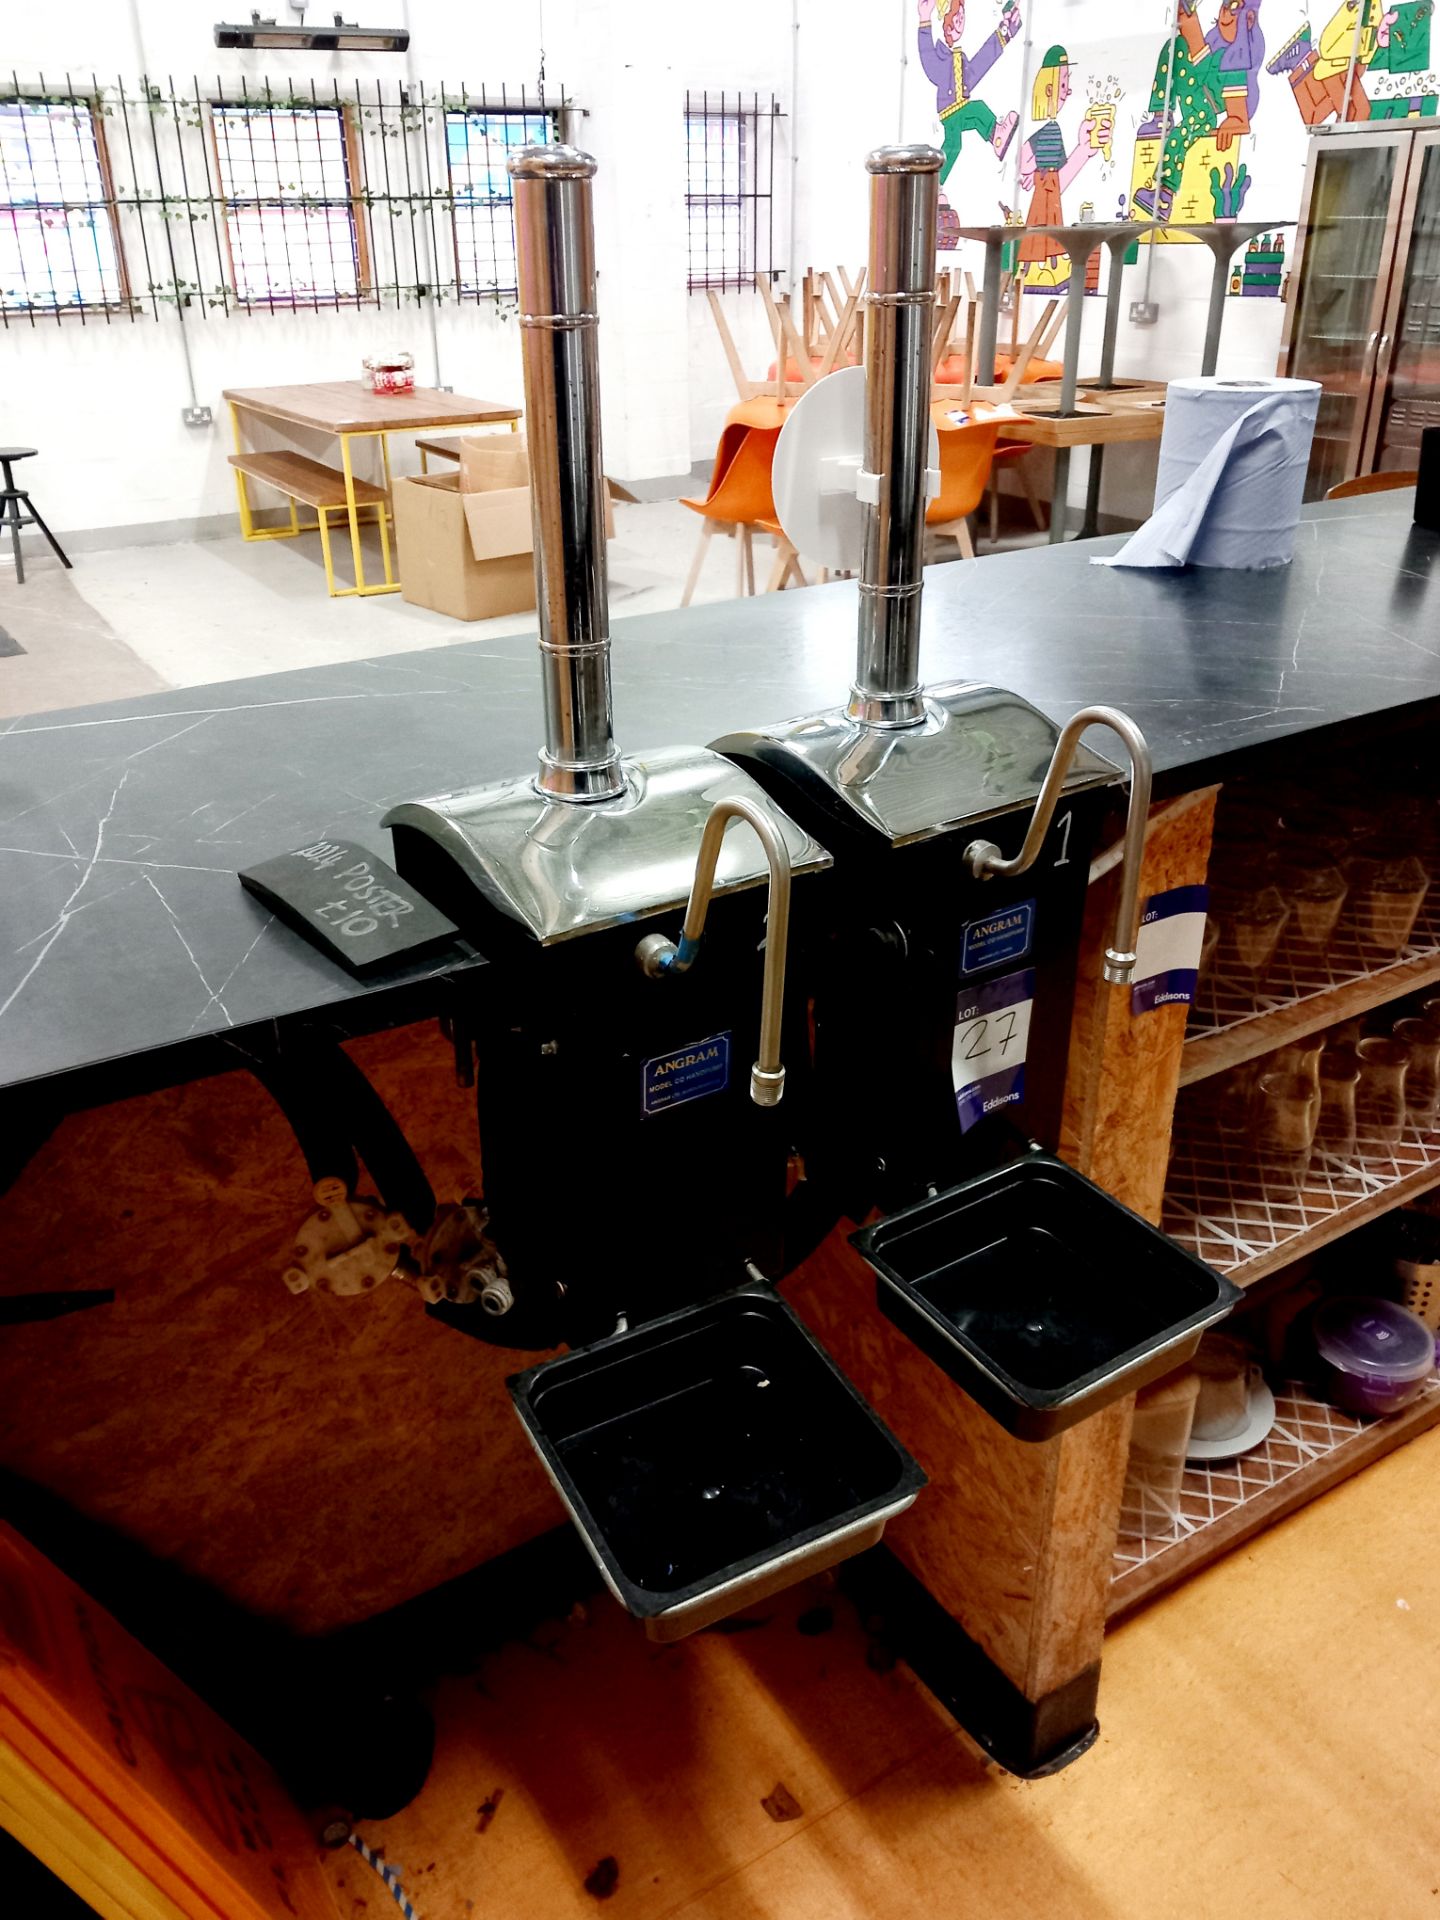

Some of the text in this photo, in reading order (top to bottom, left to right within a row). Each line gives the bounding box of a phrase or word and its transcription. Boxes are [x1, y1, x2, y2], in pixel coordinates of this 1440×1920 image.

[1053, 810, 1072, 867] 1
[333, 862, 414, 928] POSTER
[314, 900, 378, 936] £10
[972, 914, 1022, 940] ANGRAM
[958, 1005, 979, 1021] LOT:
[960, 1011, 1018, 1060] 27
[654, 1046, 719, 1077] ANGRAM
